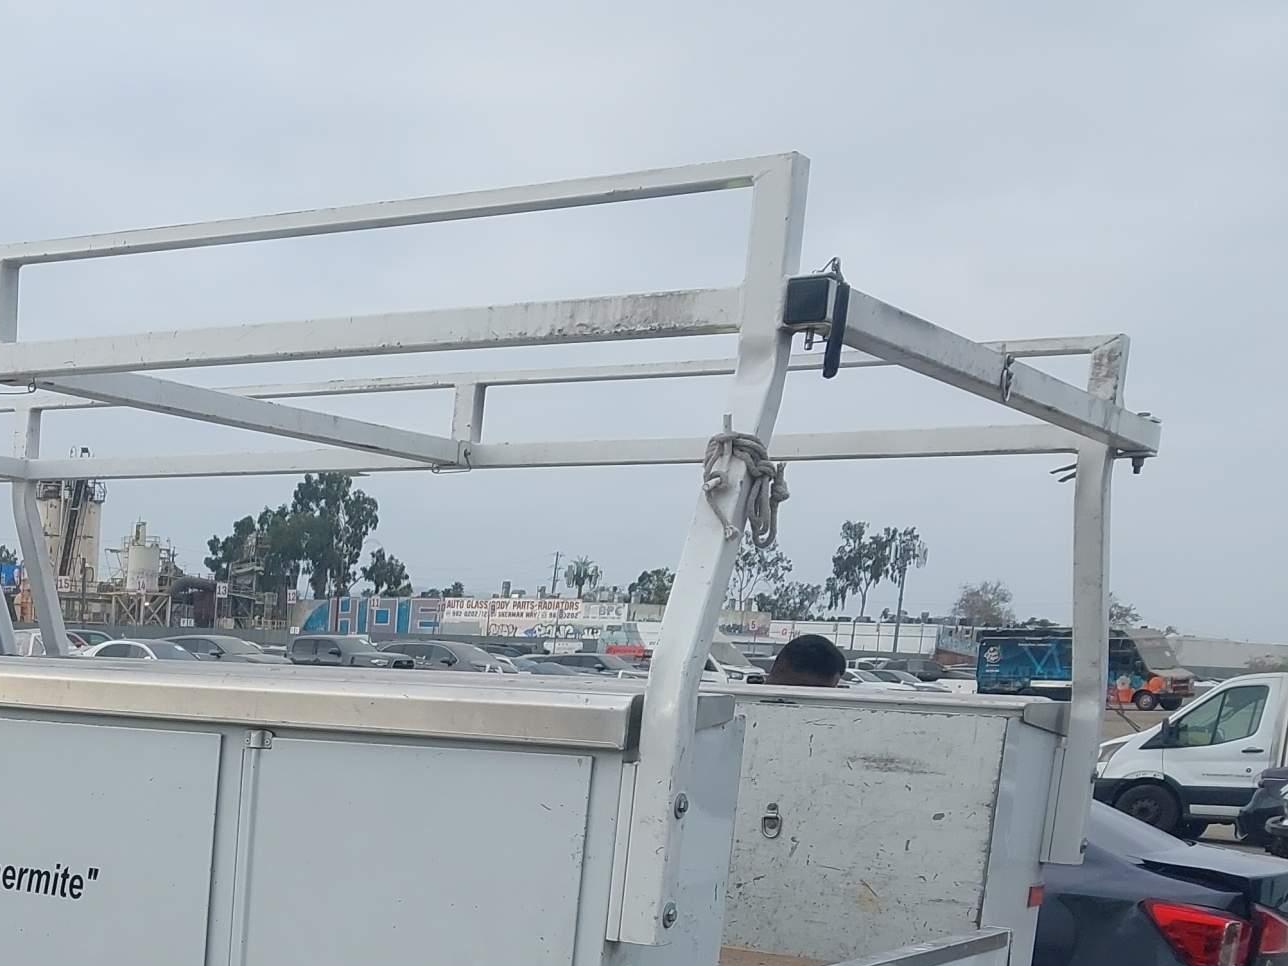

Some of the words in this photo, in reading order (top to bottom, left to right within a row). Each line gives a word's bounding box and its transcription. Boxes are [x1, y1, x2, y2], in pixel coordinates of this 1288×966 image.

[58, 578, 70, 589] 15
[137, 580, 146, 590] 14
[217, 584, 227, 595] 13
[288, 591, 296, 600] 12
[447, 600, 465, 609] AUTO
[467, 600, 489, 609] GLASS
